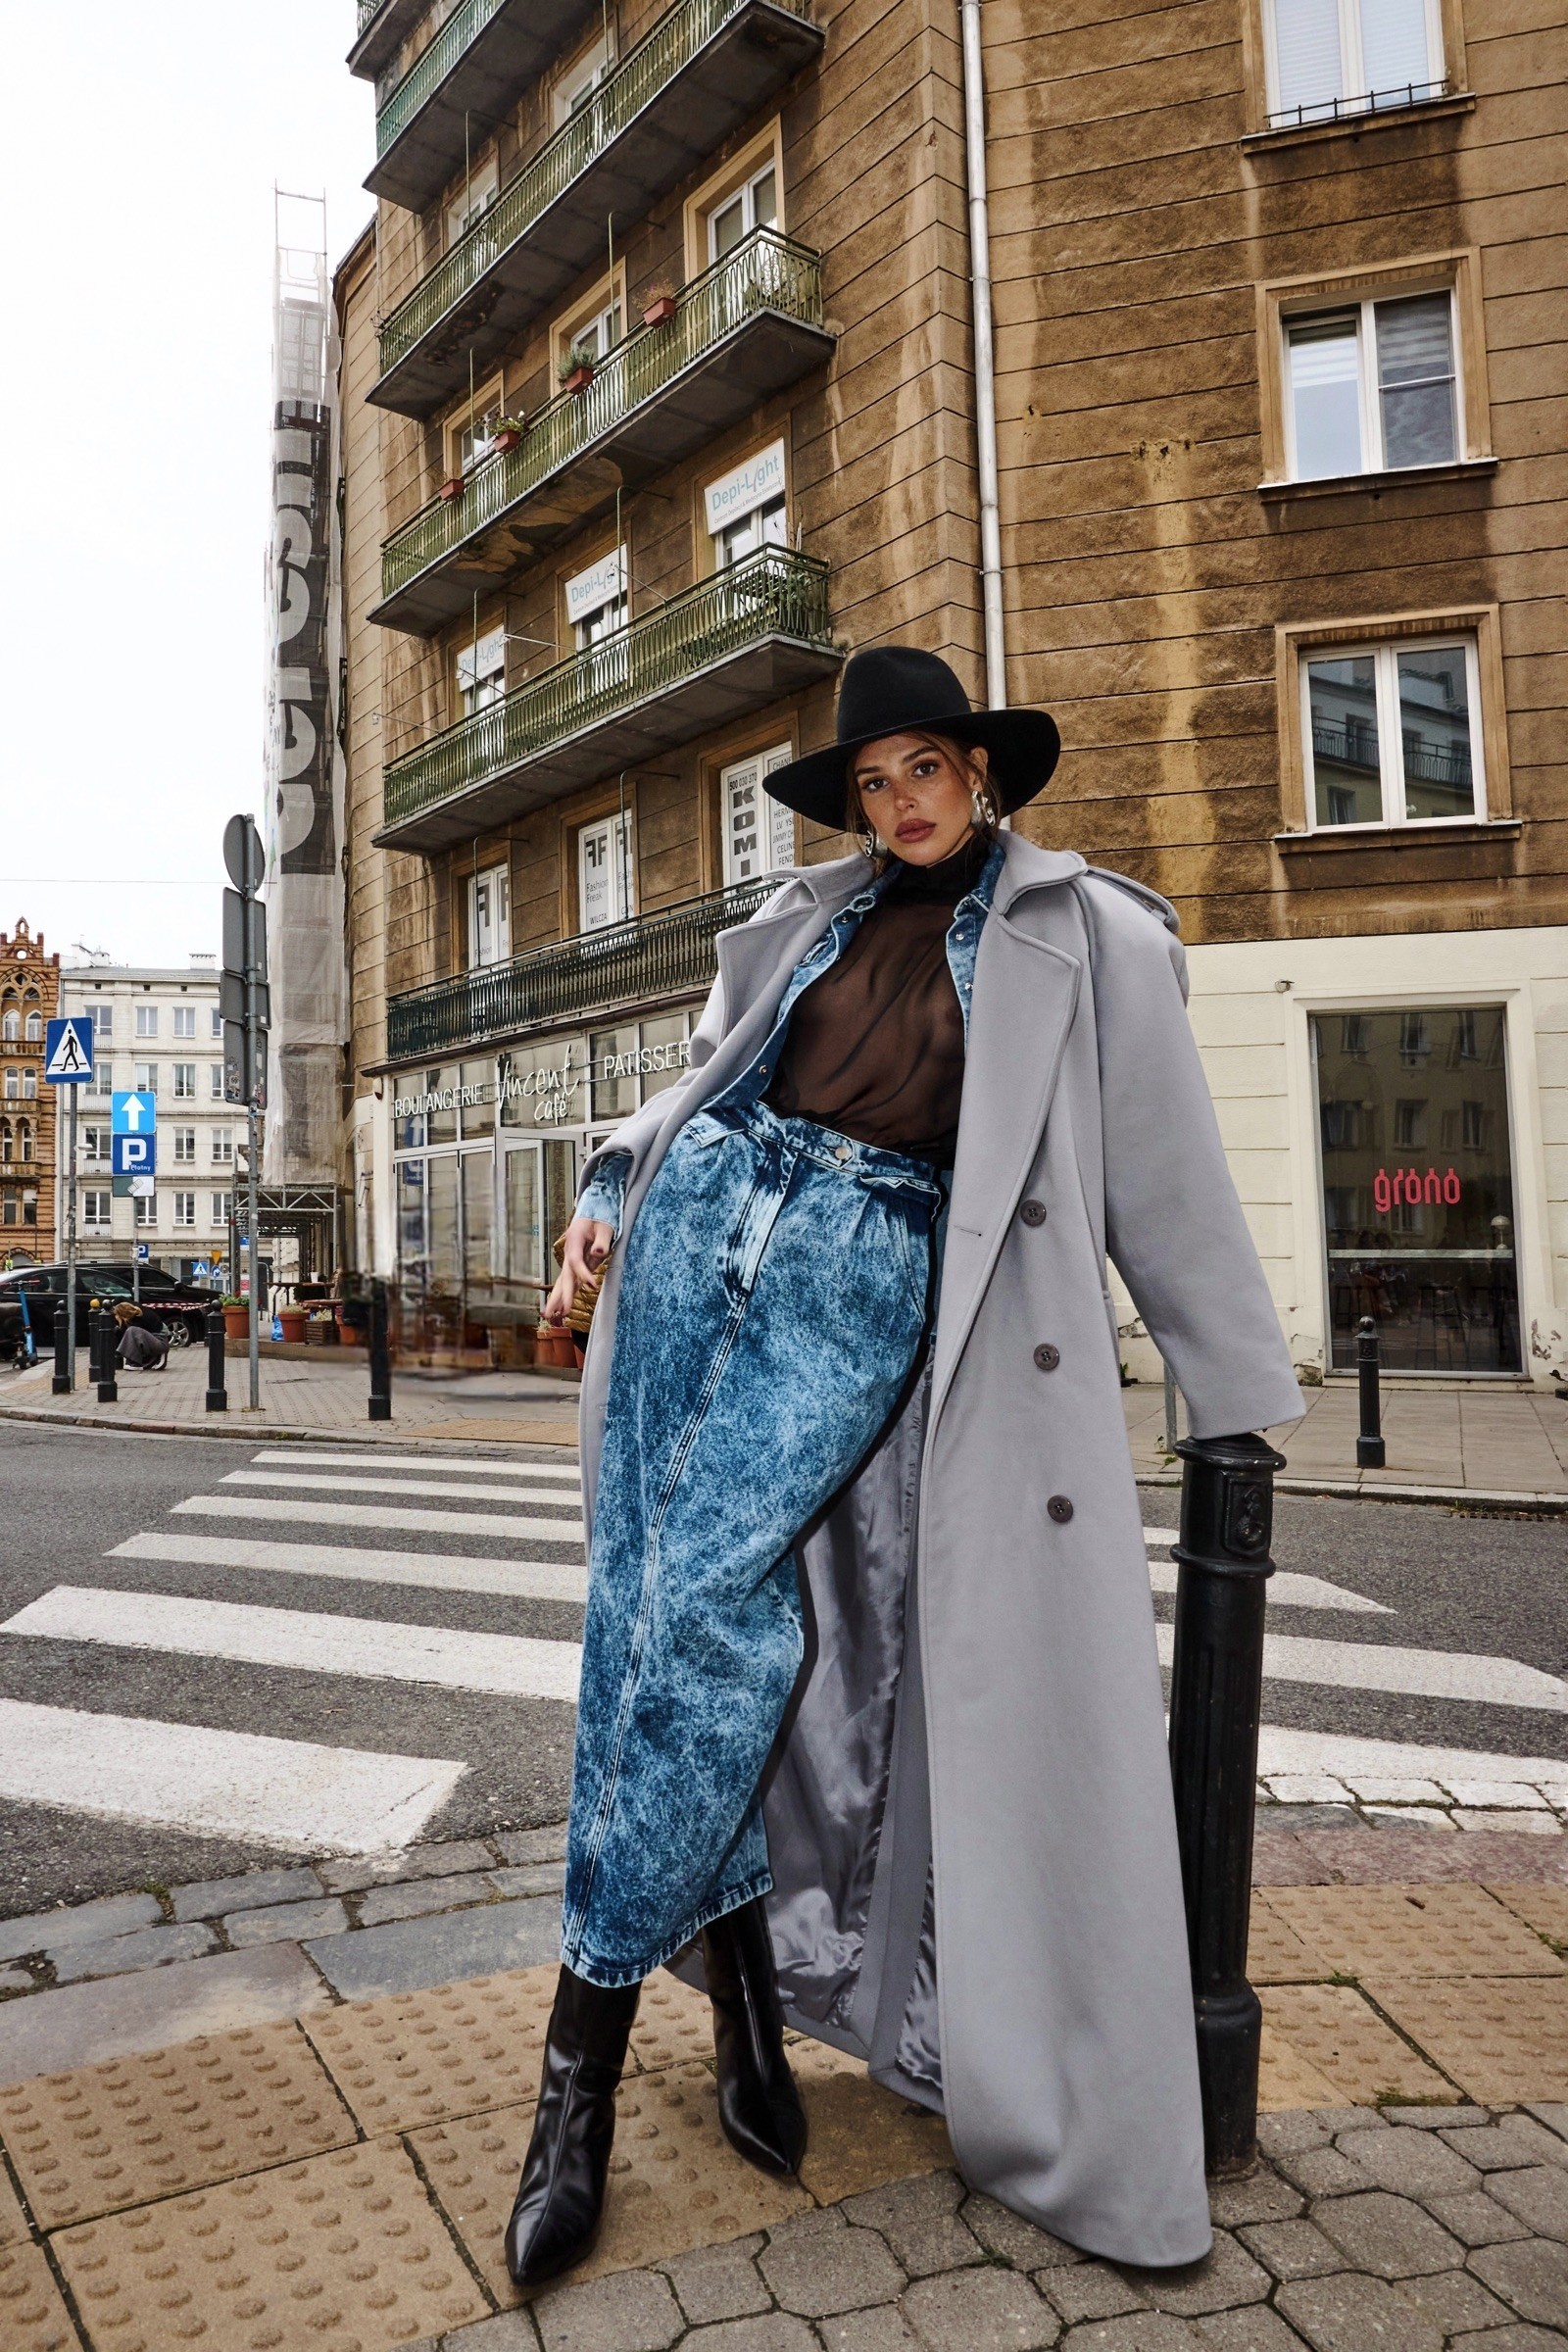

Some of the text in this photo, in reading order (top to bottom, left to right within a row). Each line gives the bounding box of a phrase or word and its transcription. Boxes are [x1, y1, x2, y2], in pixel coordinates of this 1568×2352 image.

[496, 1044, 579, 1109] Vincent
[394, 1083, 483, 1118] BOULANGERIE
[534, 1093, 567, 1126] café
[122, 1138, 146, 1170] P
[1374, 1167, 1460, 1213] grono
